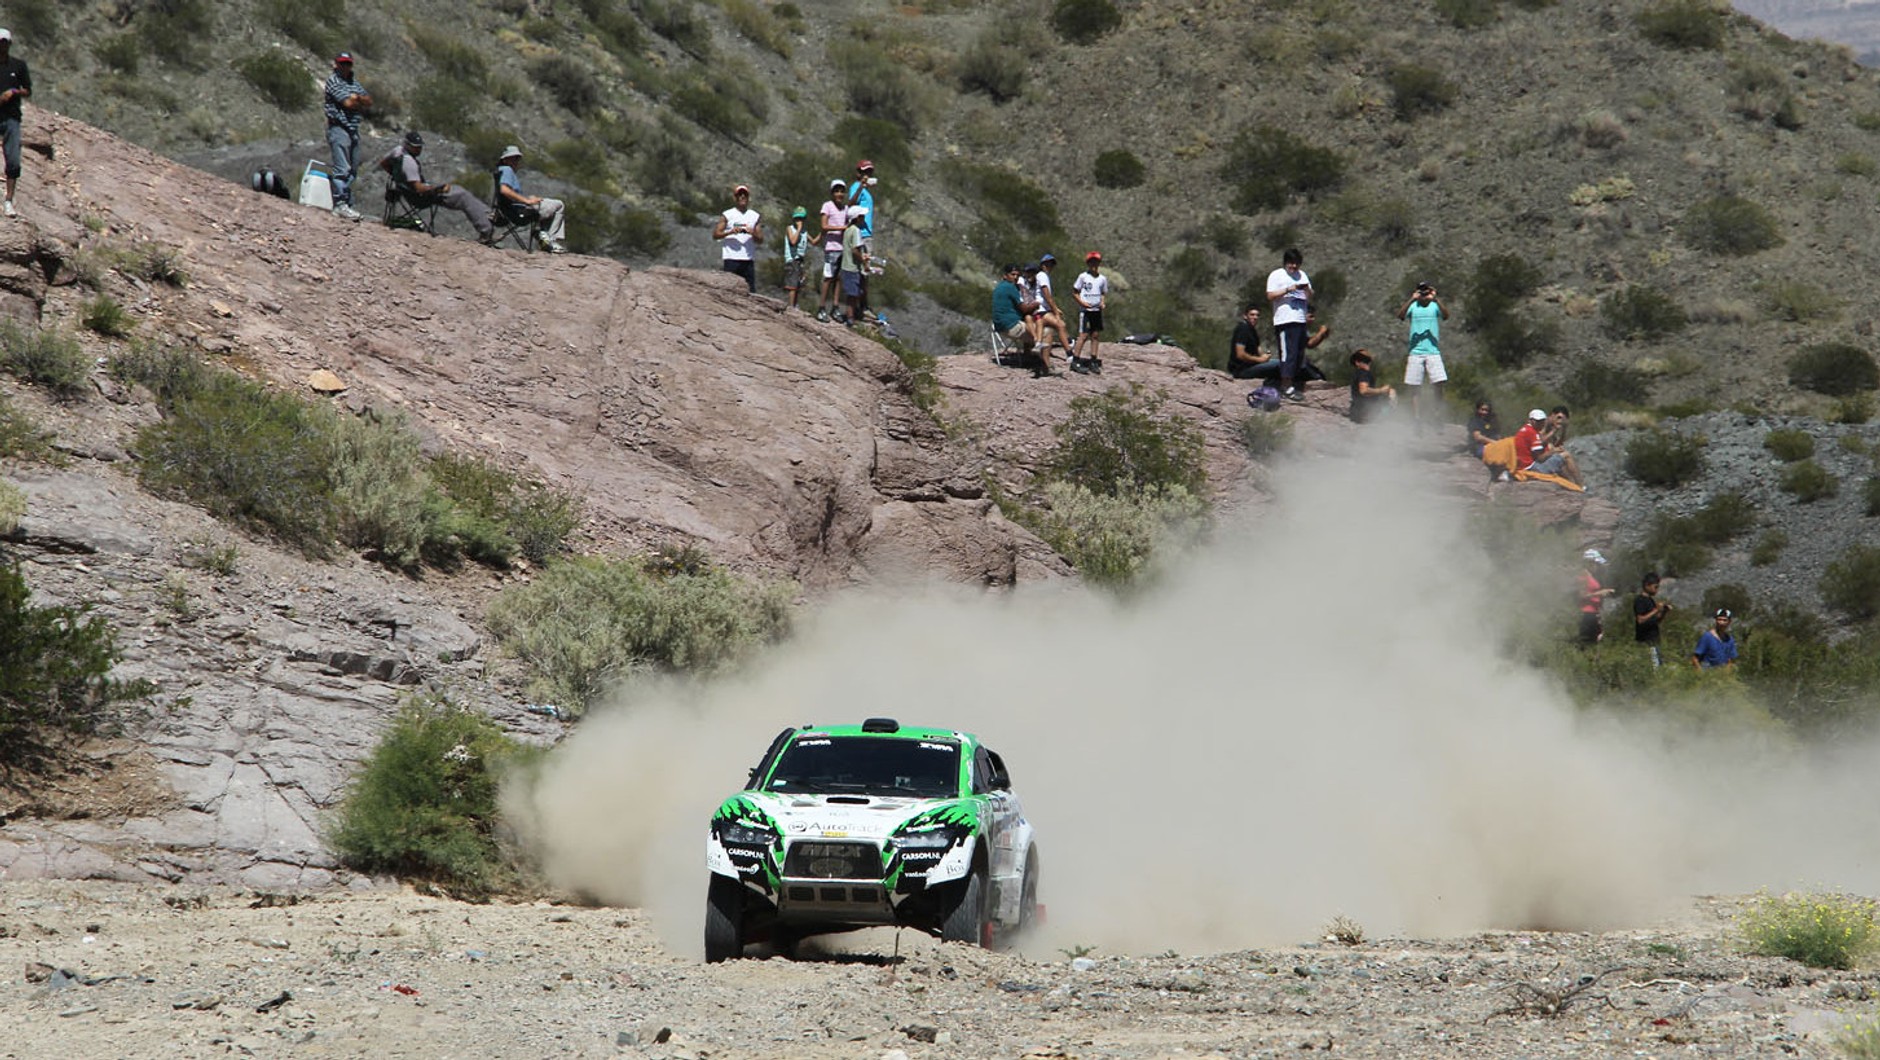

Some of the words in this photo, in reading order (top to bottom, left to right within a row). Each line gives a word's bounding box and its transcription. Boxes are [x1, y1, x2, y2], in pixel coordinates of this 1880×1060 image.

[808, 822, 882, 833] AutoTrack
[728, 847, 765, 859] CARSOM.NL
[901, 852, 942, 860] CARSOM.NL
